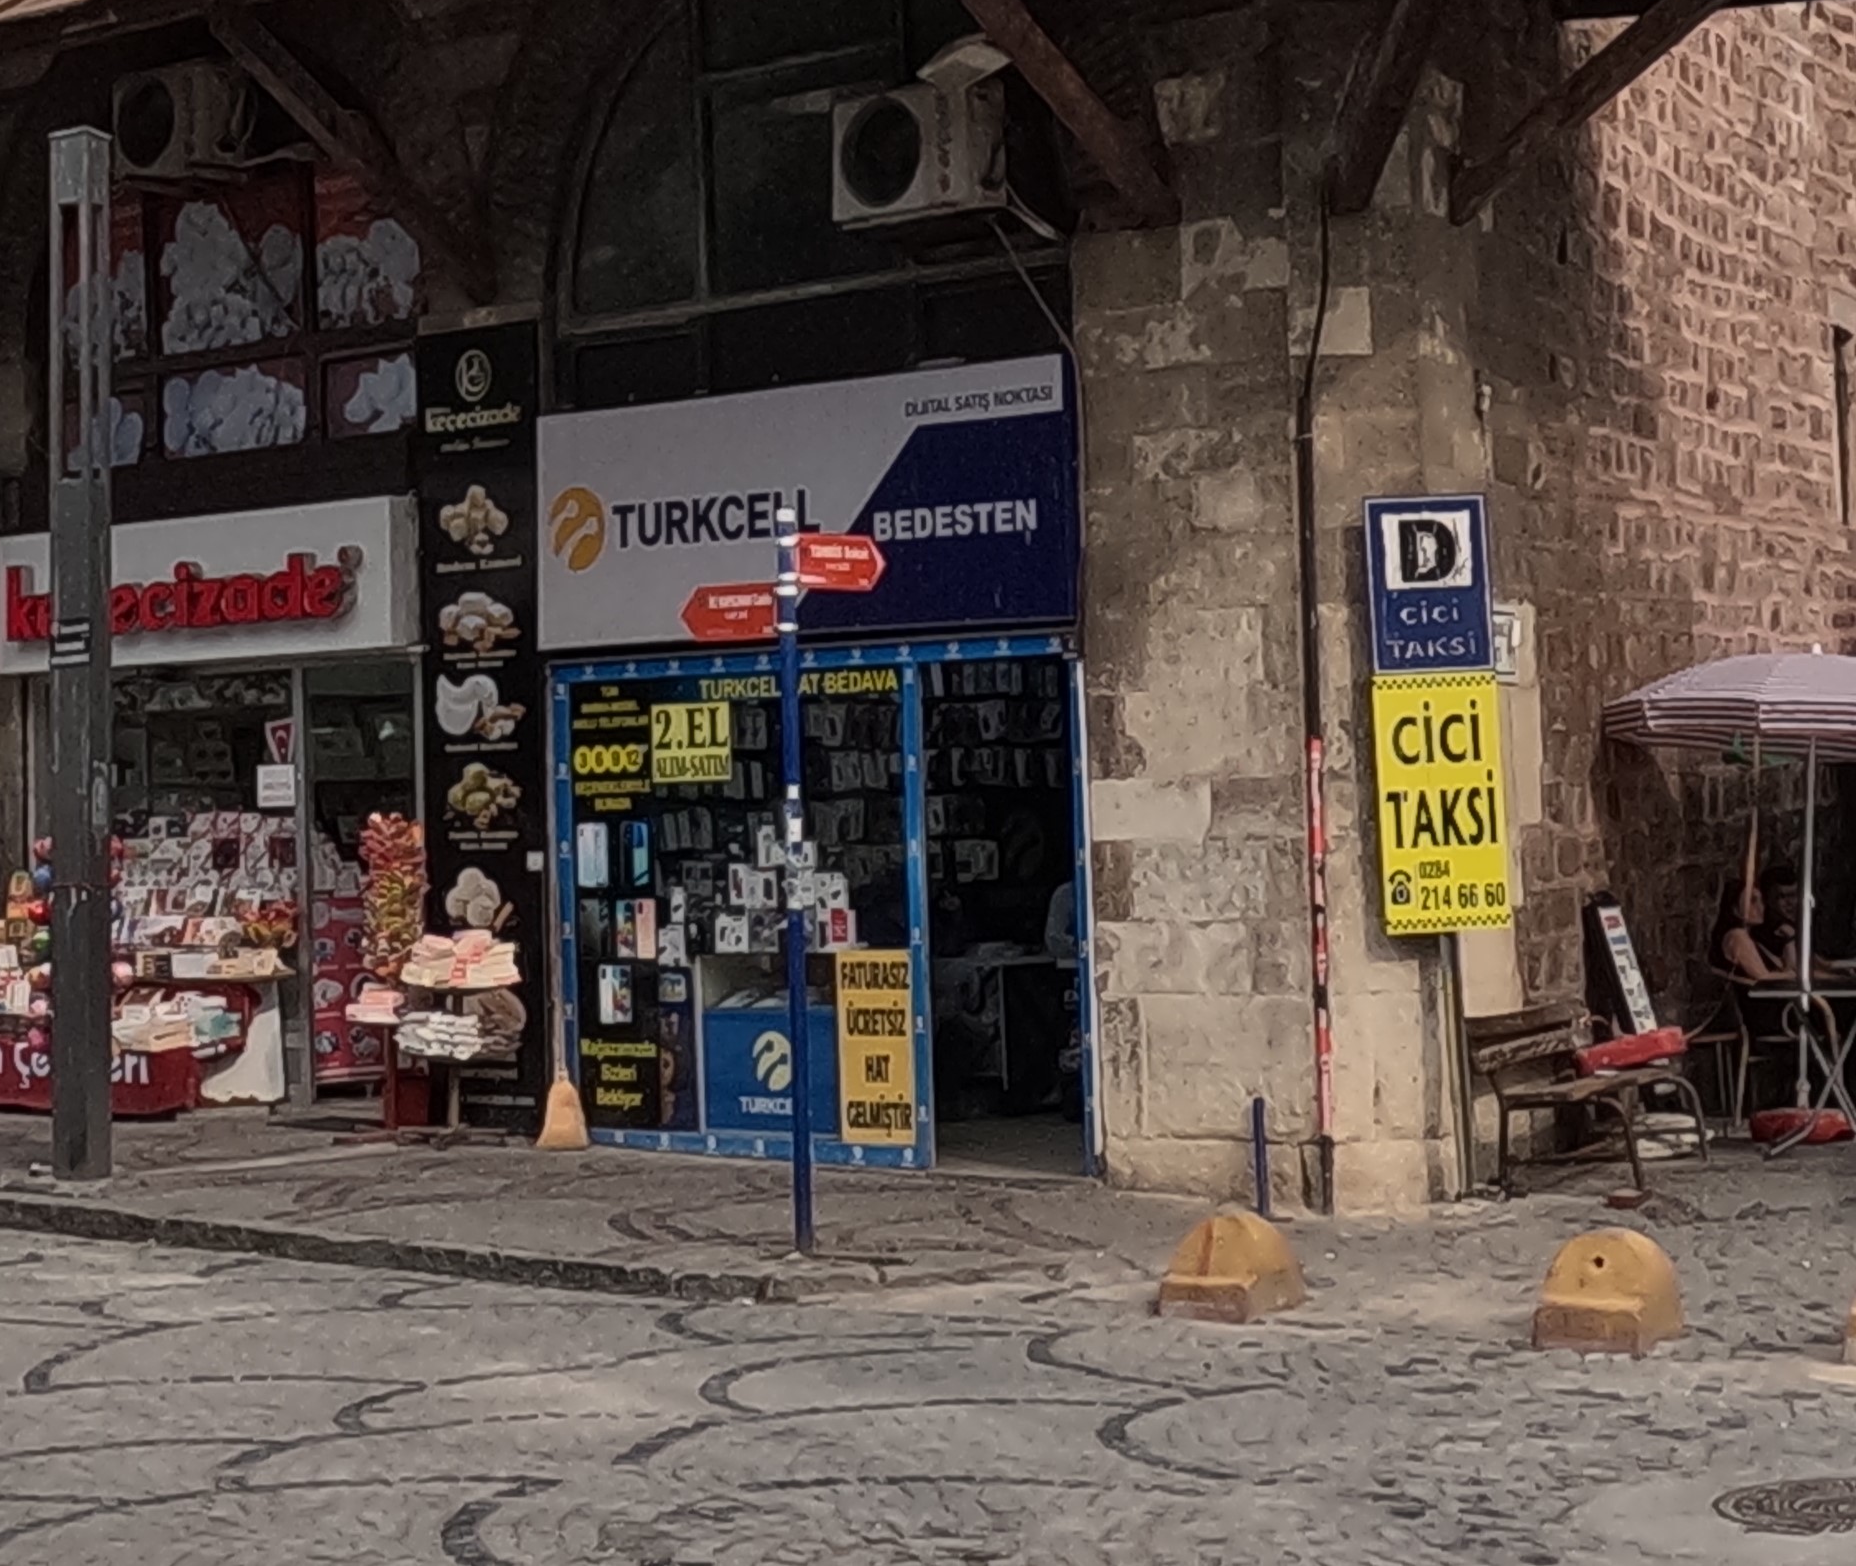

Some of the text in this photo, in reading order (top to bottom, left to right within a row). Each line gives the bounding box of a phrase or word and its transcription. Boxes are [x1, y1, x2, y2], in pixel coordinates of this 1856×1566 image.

[994, 385, 1053, 407] NOKTASI
[872, 498, 1038, 542] BEDESTEN
[1398, 518, 1457, 583] D
[6, 552, 343, 642] kecizade
[698, 675, 782, 701] TURKCEL
[823, 668, 899, 695] BEDAVA
[654, 706, 729, 751] 2.EL
[655, 753, 730, 778] ALIM-SATIM
[1385, 768, 1500, 851] TAKSİ
[1419, 861, 1451, 880] 0284
[1421, 882, 1506, 911] 214 66 60
[840, 960, 910, 991] FATURASIZ
[845, 999, 907, 1037] ÜCRETSİZ
[865, 1055, 891, 1083] HAT
[739, 1095, 793, 1116] TURKCE
[846, 1092, 913, 1138] GELMİŞTİR
